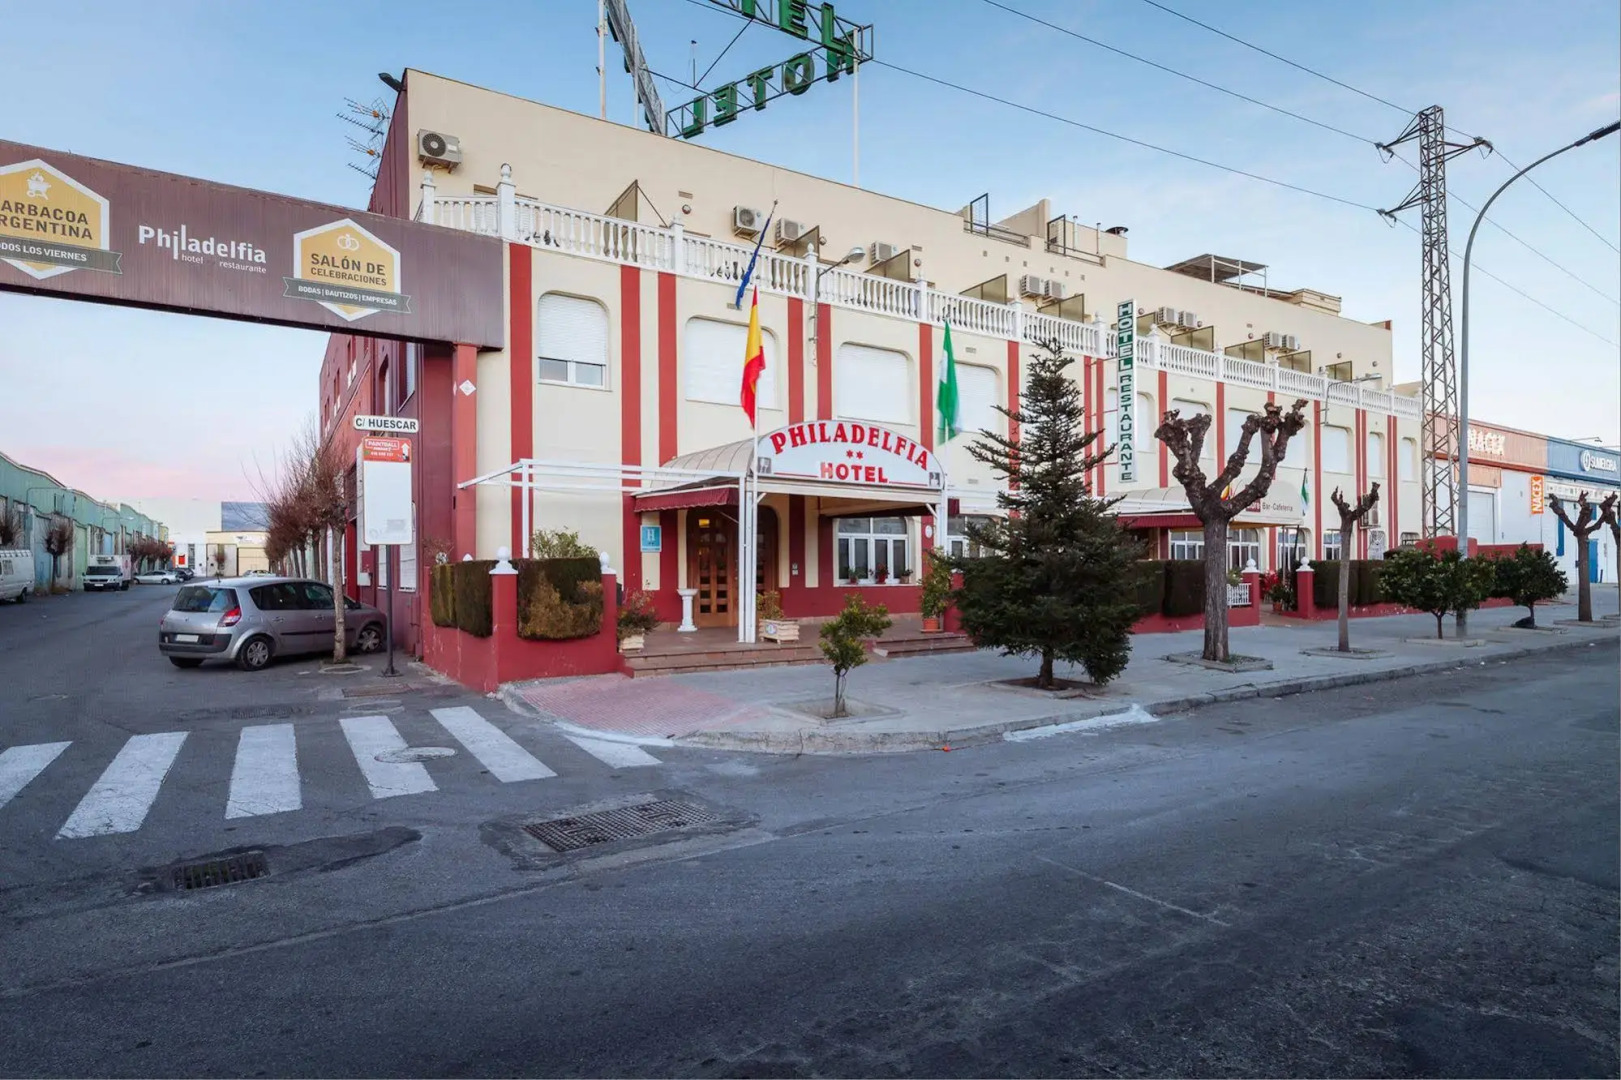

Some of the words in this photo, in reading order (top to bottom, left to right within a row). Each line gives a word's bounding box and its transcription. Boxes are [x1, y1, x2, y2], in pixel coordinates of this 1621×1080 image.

[0, 200, 88, 225] ARBACOA
[0, 214, 93, 240] RGENTINA
[0, 242, 21, 252] DOS
[23, 246, 42, 255] LOS
[44, 248, 87, 262] VIERNES
[139, 224, 267, 263] Philadelfia
[181, 253, 204, 264] hotel
[219, 260, 267, 274] restaurante
[311, 253, 361, 272] SALÓN
[366, 262, 386, 276] DE
[310, 267, 387, 287] CELEBRACIONES
[298, 285, 321, 295] BODAS
[325, 290, 358, 301] BAUTIZOS
[361, 294, 398, 306] EMPRESAS
[1118, 302, 1133, 372] HOTEL
[356, 418, 365, 427] C/
[368, 419, 416, 430] HUESCAR
[1119, 374, 1133, 481] RESTAURANTE
[769, 422, 929, 471] PHILADELFIA
[820, 461, 889, 484] HOTEL
[1532, 479, 1543, 512] NACEX
